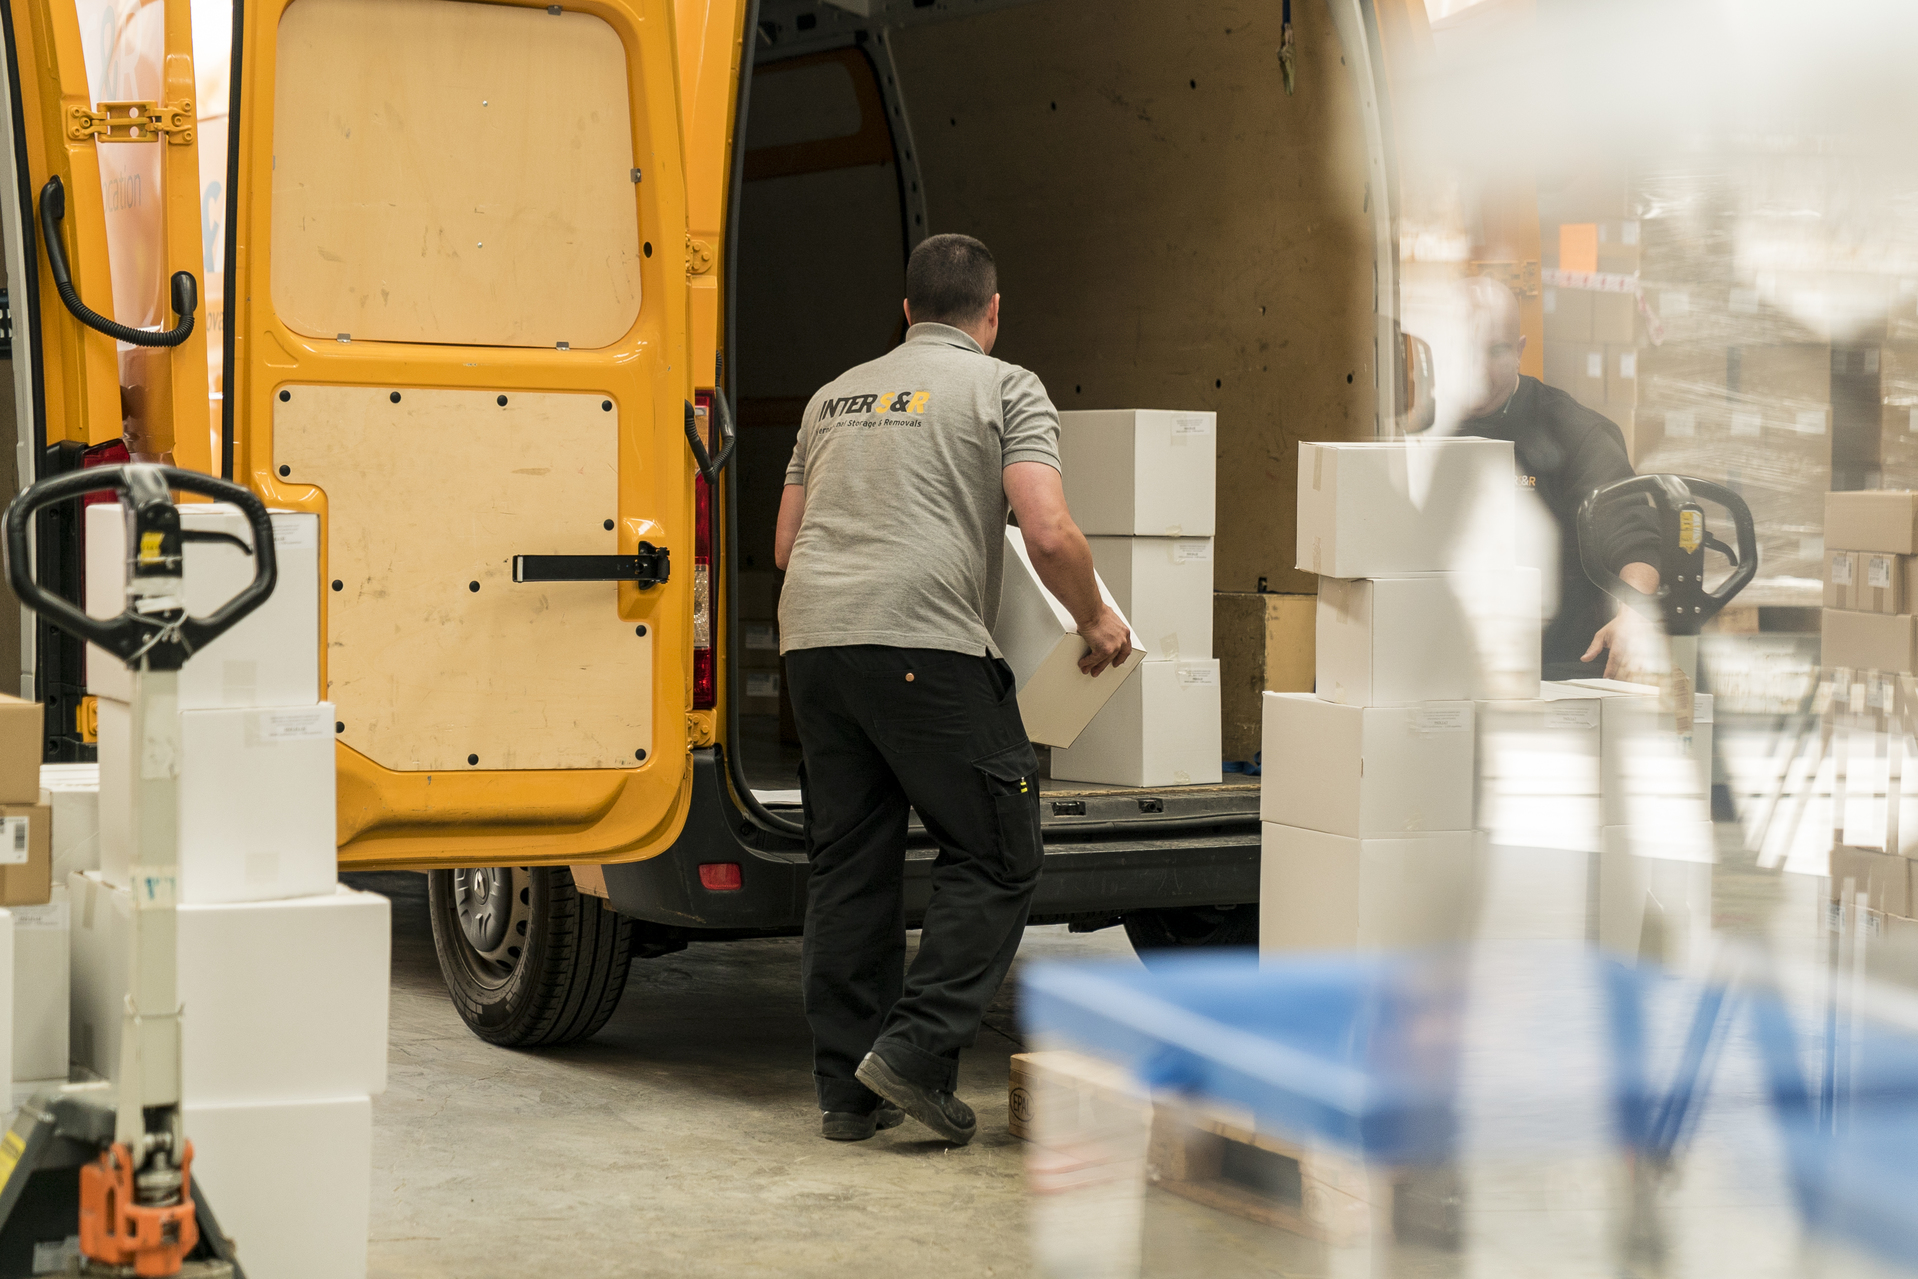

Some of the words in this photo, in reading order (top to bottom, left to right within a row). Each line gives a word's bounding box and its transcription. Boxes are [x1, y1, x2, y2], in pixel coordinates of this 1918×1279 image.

[847, 419, 877, 428] Storage
[883, 418, 922, 428] Removals
[1013, 1093, 1031, 1116] EPAL
